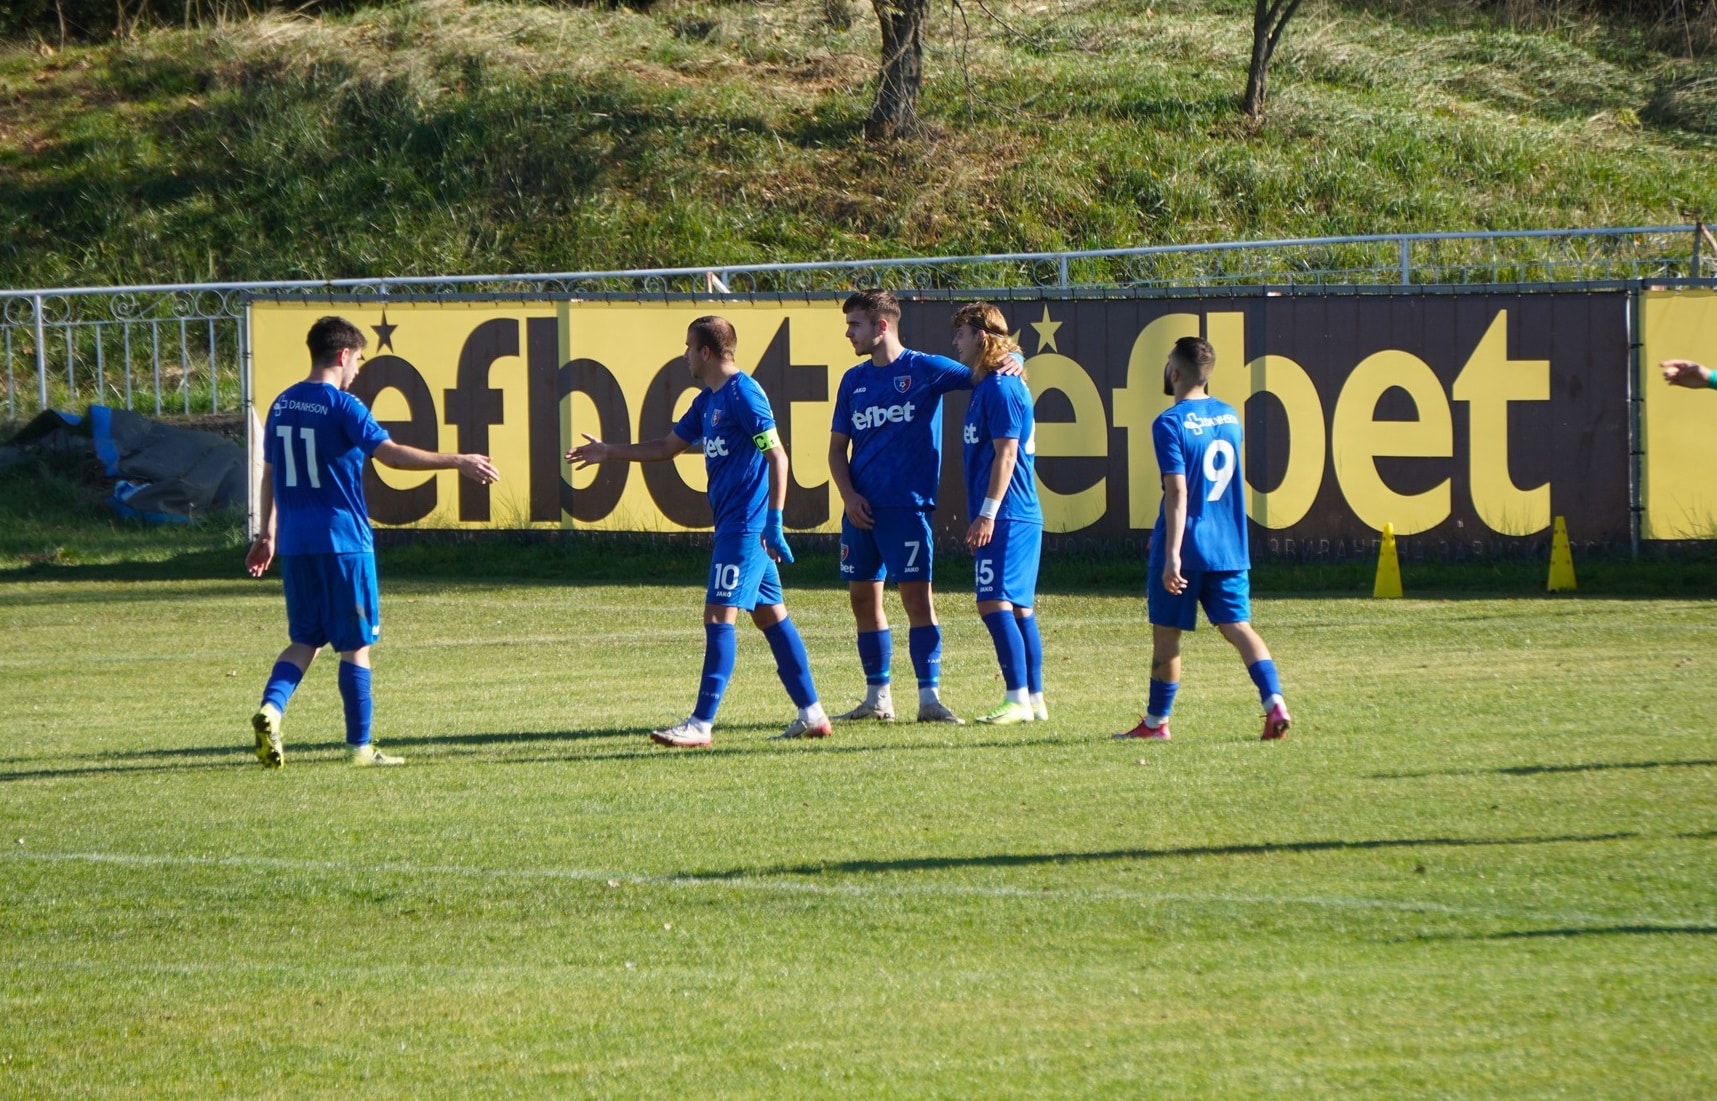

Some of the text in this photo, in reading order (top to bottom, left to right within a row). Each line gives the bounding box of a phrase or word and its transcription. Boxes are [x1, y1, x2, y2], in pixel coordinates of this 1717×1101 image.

[349, 317, 830, 530] efbet
[851, 401, 916, 431] efbet
[1024, 309, 1551, 537] efbet
[276, 425, 321, 488] 11
[755, 435, 767, 450] C
[1203, 439, 1236, 502] 9
[714, 563, 740, 590] 10
[904, 541, 920, 567] 7
